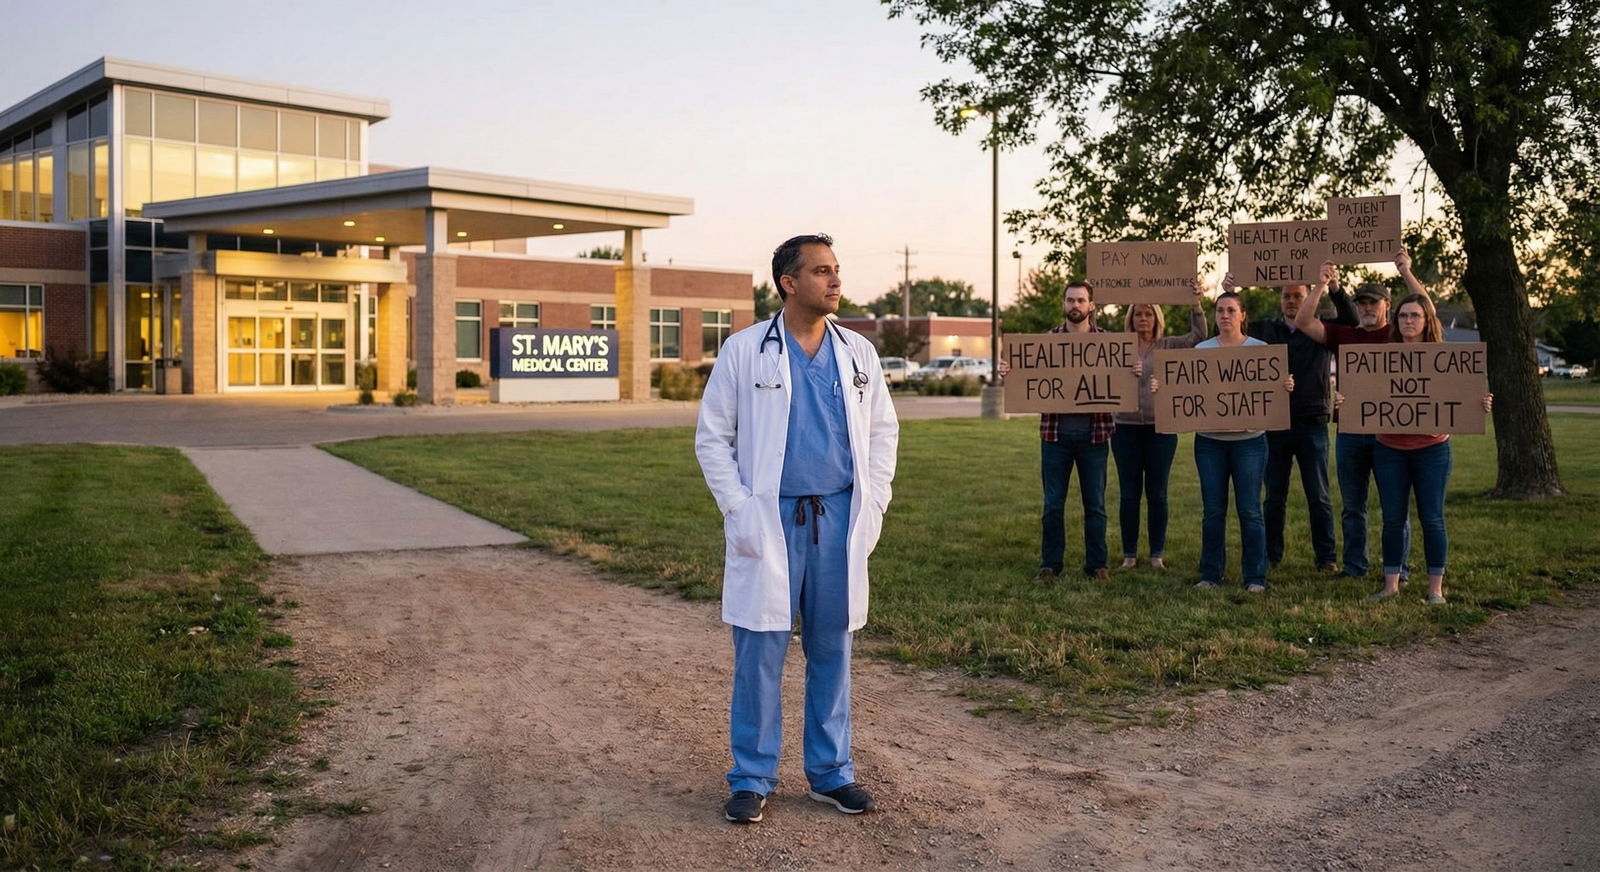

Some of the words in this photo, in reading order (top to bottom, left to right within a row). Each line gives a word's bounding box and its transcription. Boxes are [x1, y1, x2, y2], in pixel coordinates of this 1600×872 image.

[1338, 201, 1388, 215] PATIENT
[1347, 216, 1379, 229] CARE
[1233, 229, 1289, 245] HEALTH
[1294, 227, 1328, 243] CARE
[1353, 230, 1374, 240] NOT
[1101, 251, 1130, 267] PAY
[1254, 249, 1280, 261] NOT
[1291, 248, 1309, 261] FOR
[512, 334, 538, 356] ST.
[543, 335, 609, 356] MARY'S
[1009, 342, 1134, 369] HEALTHCARE
[1346, 351, 1426, 374] PATIENT
[1434, 350, 1483, 374] CARE
[512, 358, 564, 372] MEDICAL
[566, 358, 609, 372] CENTER
[1165, 359, 1210, 385] FAIR
[1217, 357, 1280, 382] WAGES
[1027, 377, 1065, 400] FOR
[1074, 374, 1121, 402] ALL
[1390, 378, 1431, 395] NOT
[1172, 395, 1206, 418] FOR
[1216, 391, 1274, 417] STAFF
[1361, 402, 1463, 427] PROFIT
